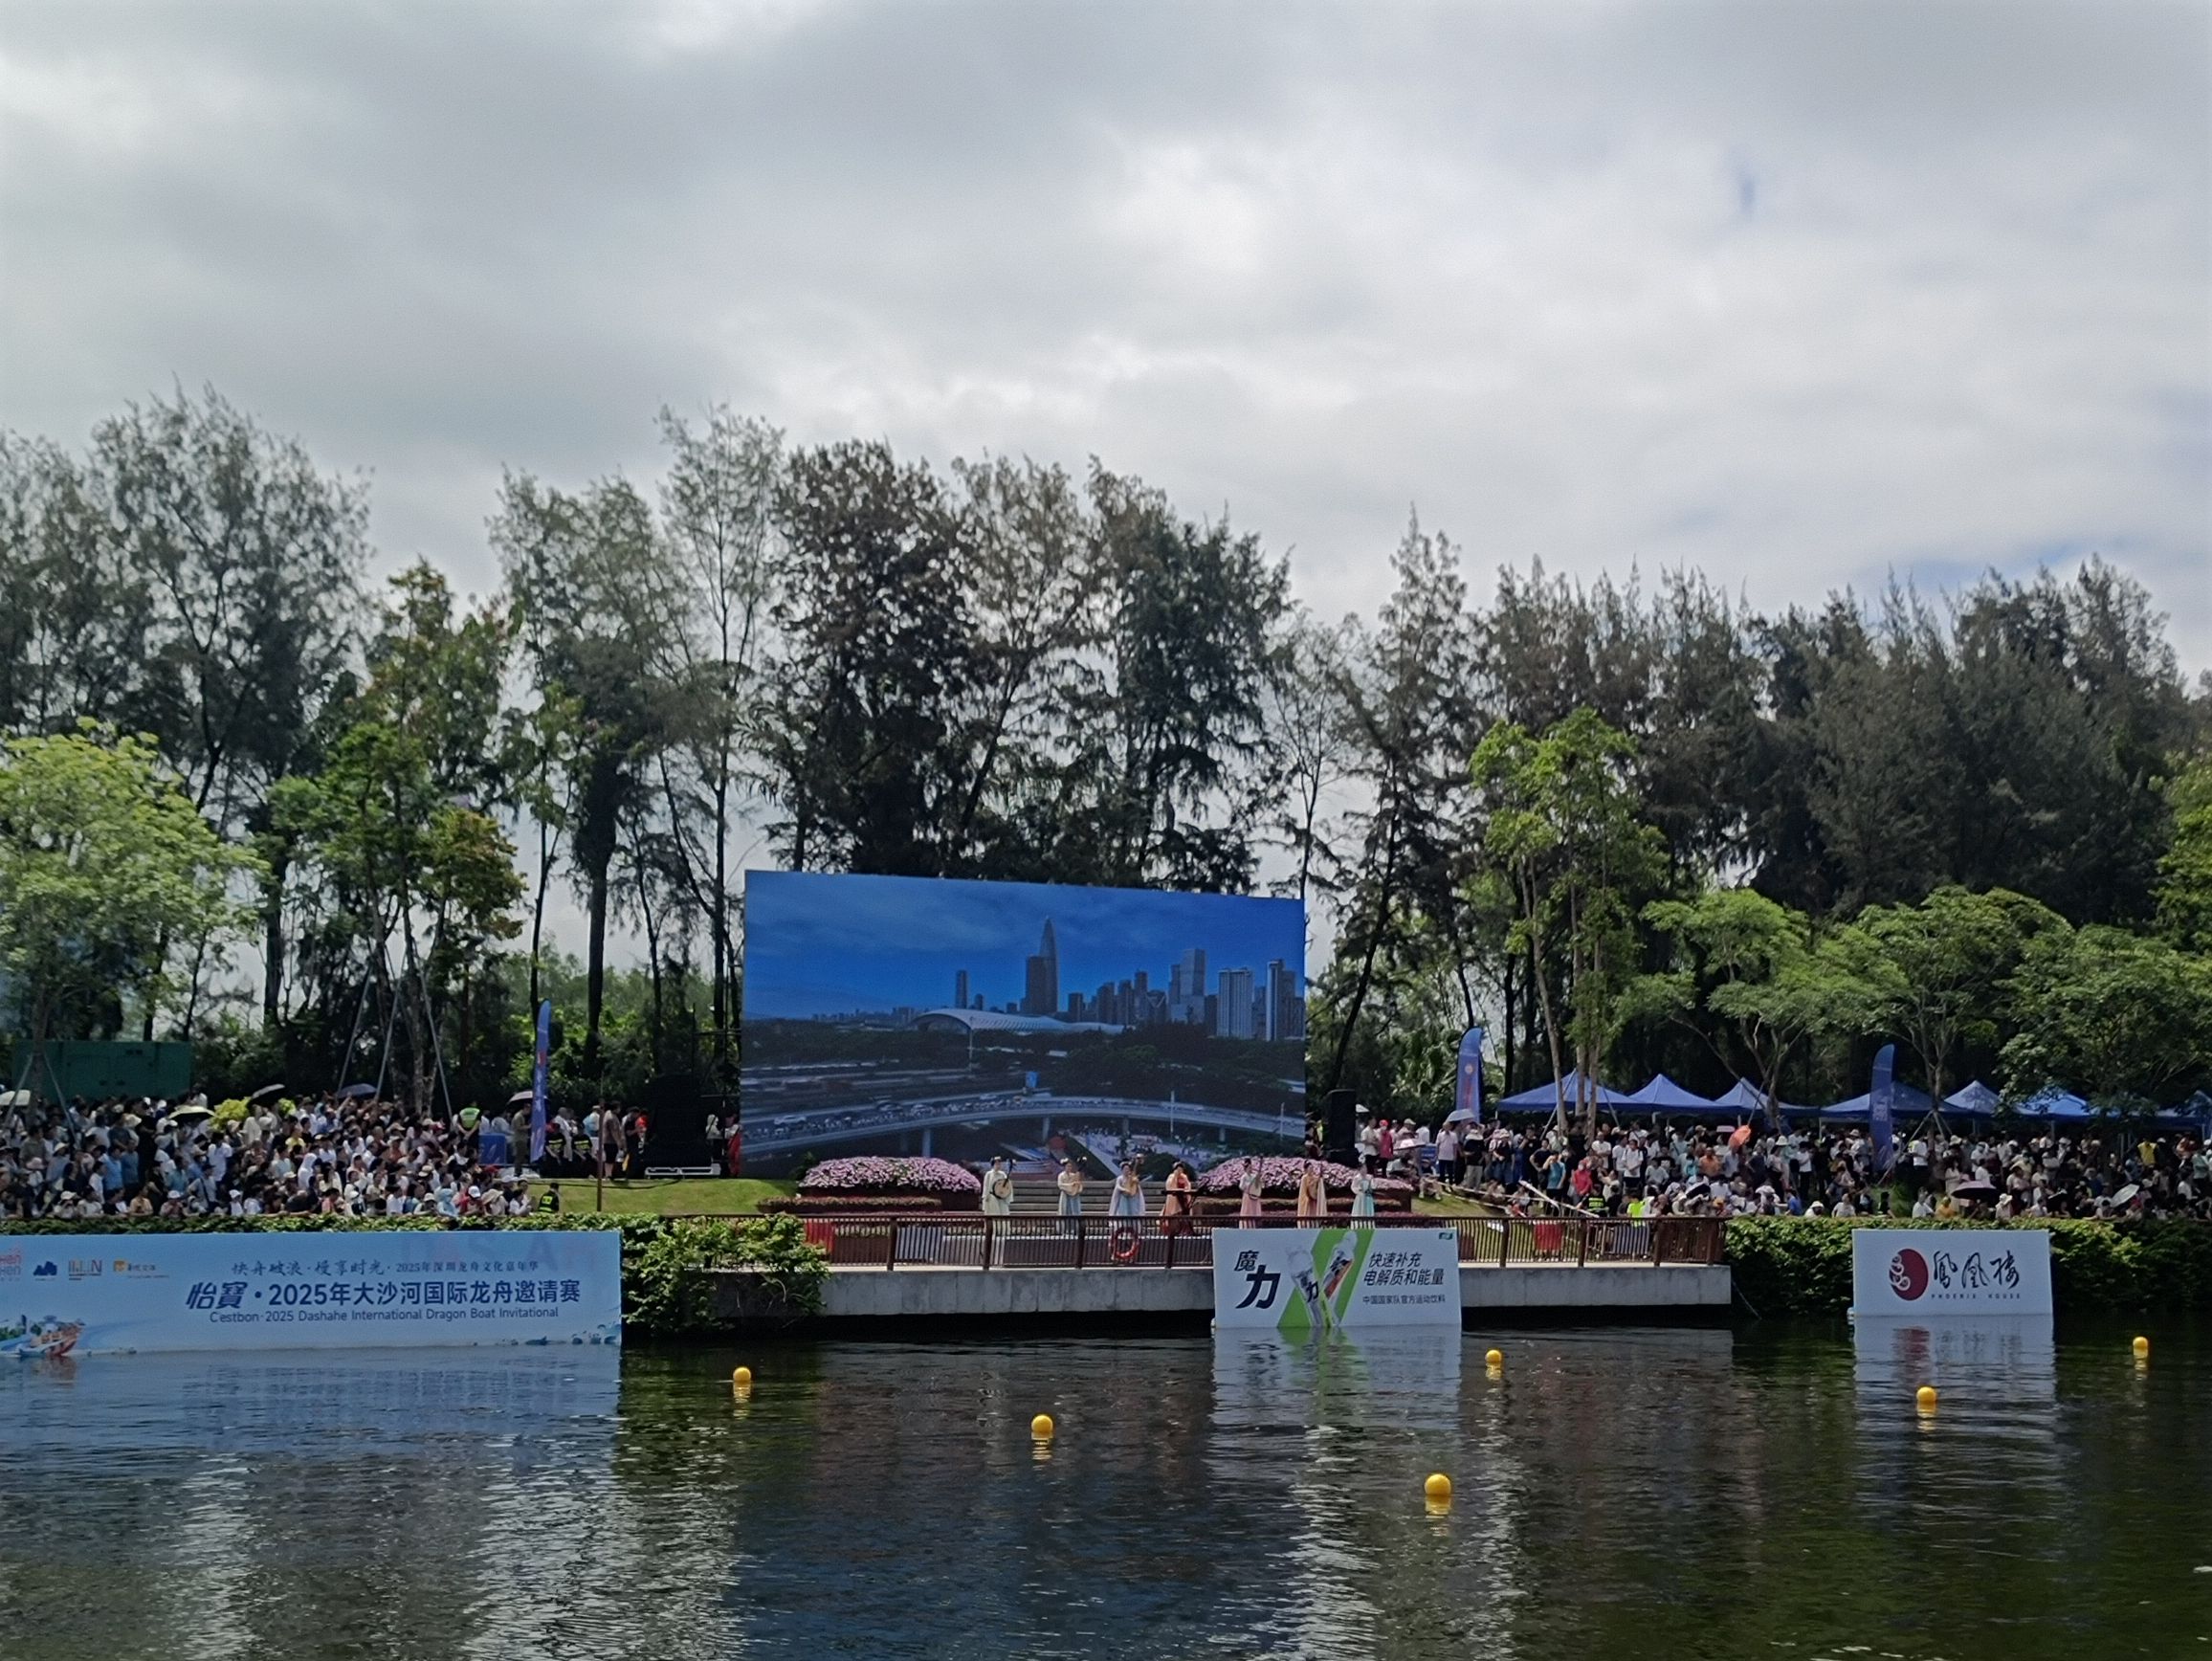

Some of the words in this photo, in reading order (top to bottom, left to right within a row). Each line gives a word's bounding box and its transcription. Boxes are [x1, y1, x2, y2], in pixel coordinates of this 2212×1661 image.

[1369, 1251, 1423, 1268] 快速补充
[1363, 1268, 1445, 1286] 电解质和能量
[299, 1310, 347, 1321] Dashahe
[351, 1308, 422, 1320] International
[426, 1308, 466, 1322] Dragon
[470, 1307, 496, 1318] Boat
[499, 1306, 559, 1318] Invitational
